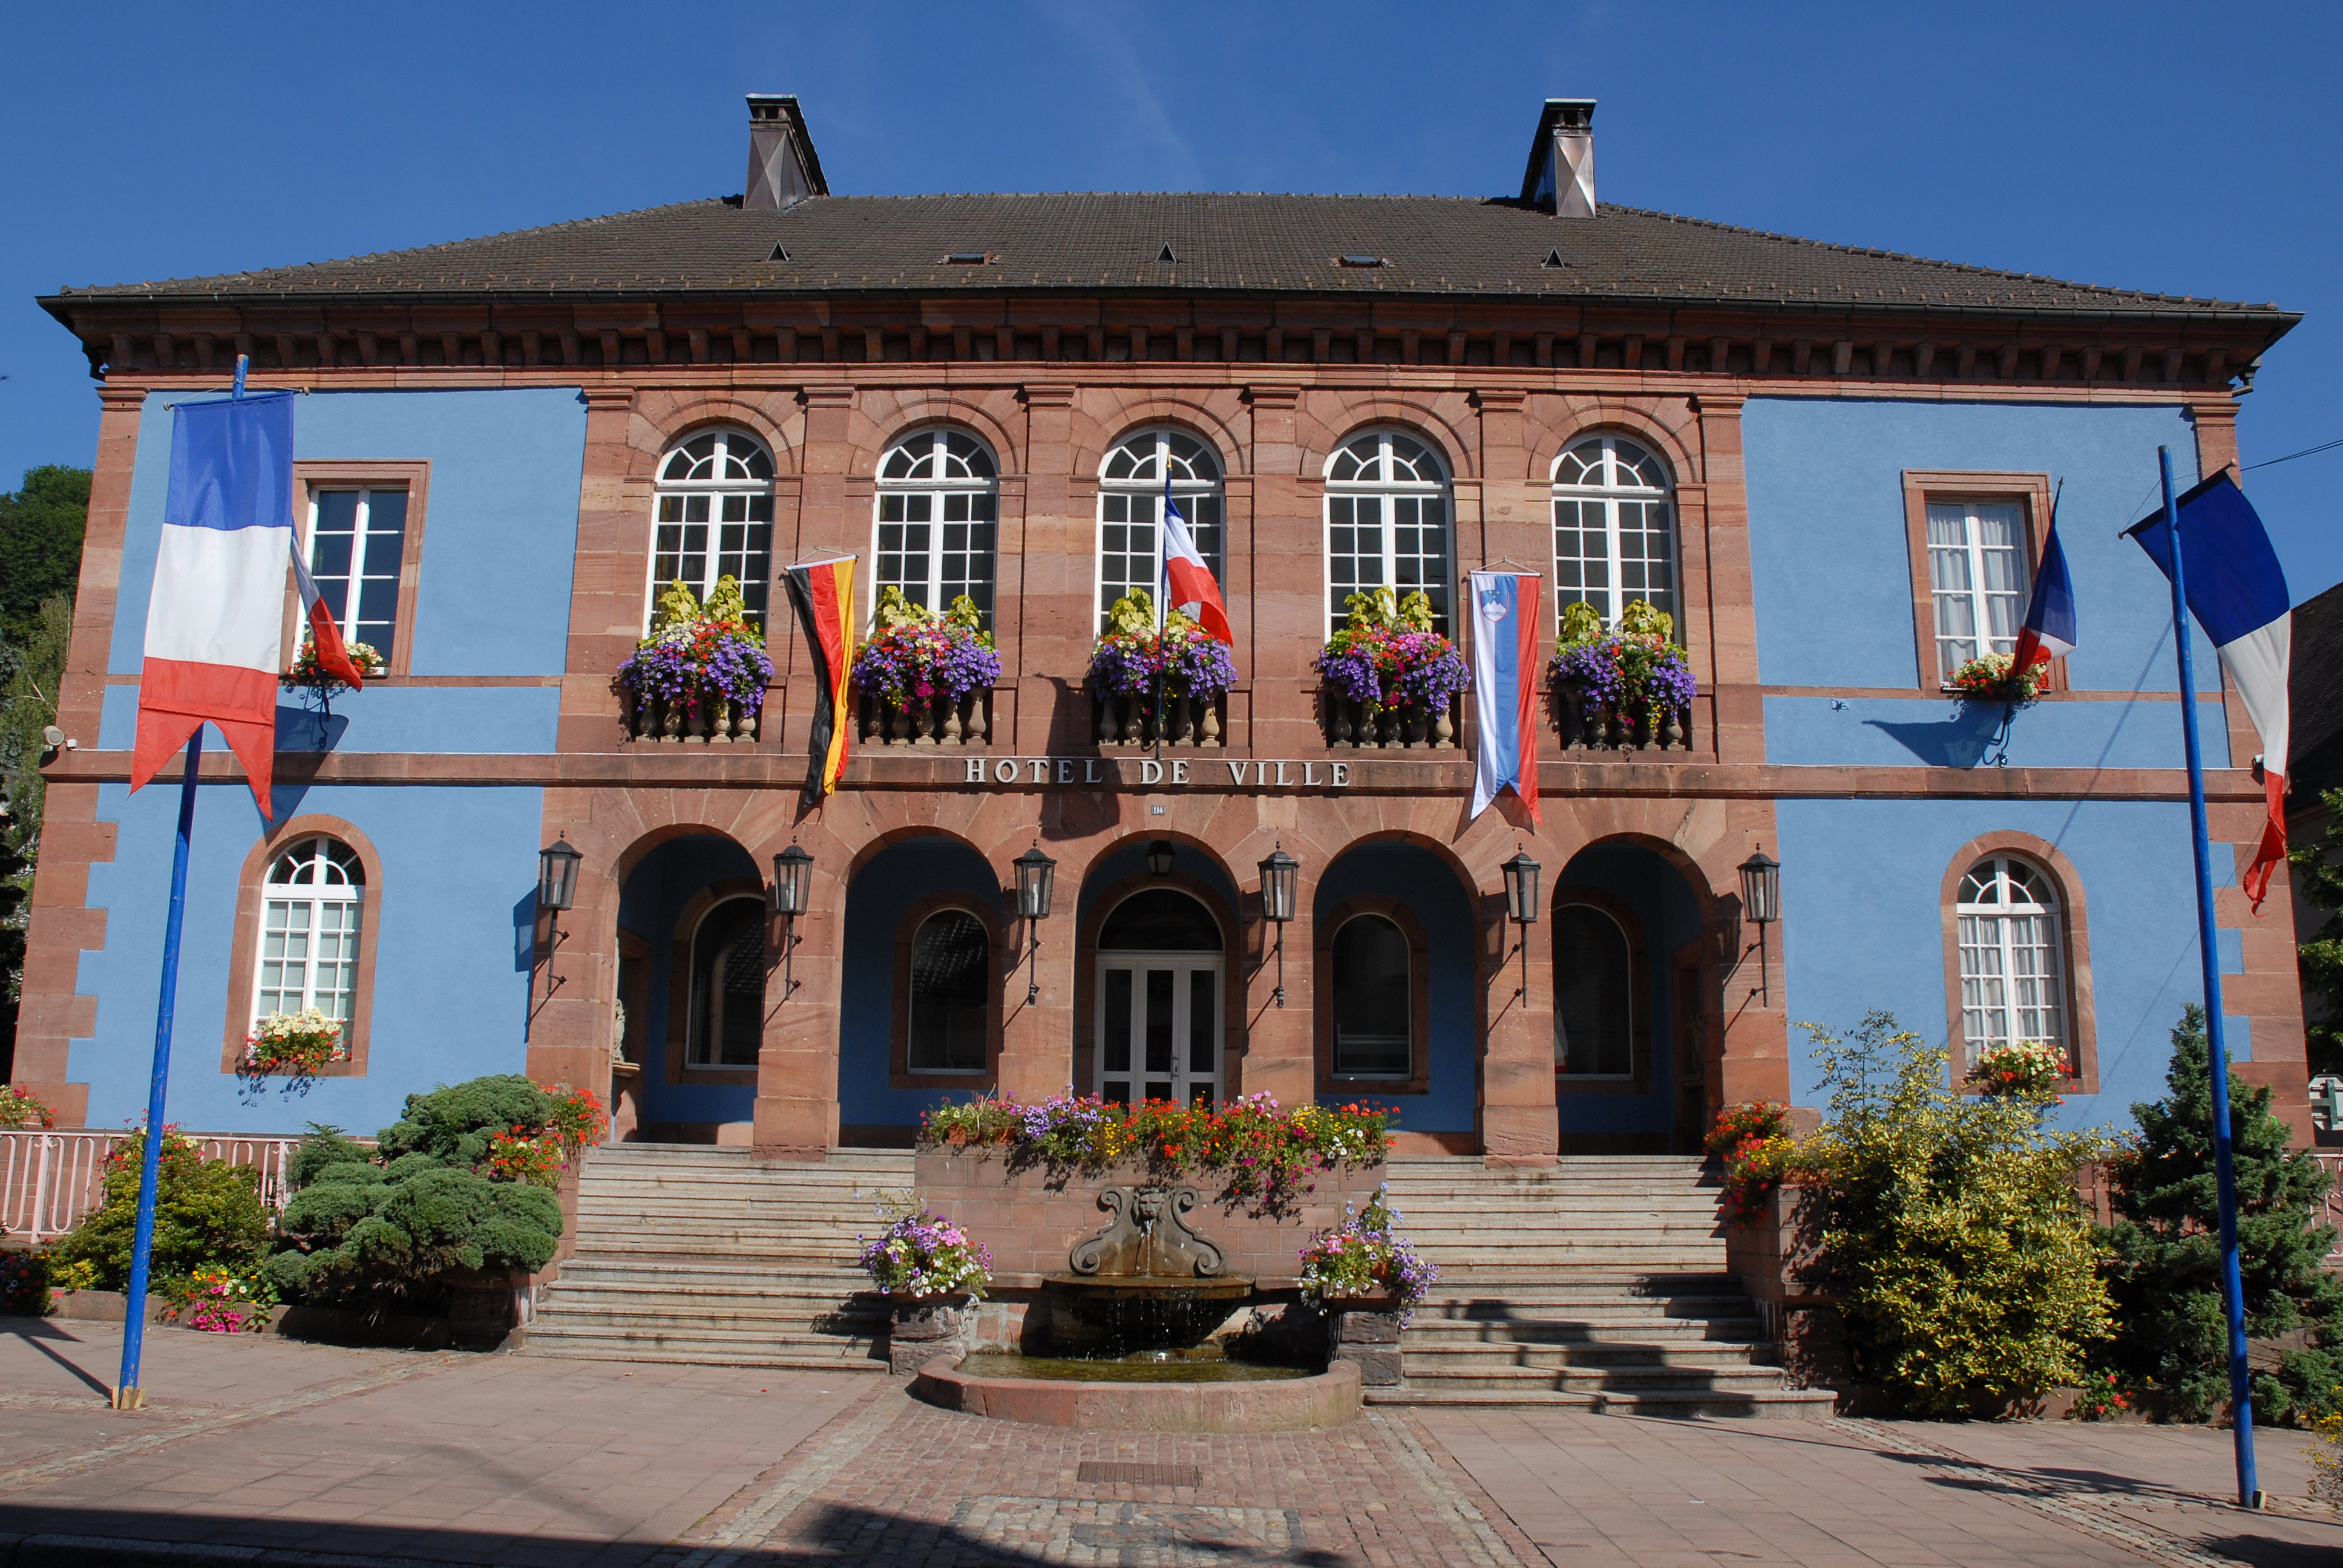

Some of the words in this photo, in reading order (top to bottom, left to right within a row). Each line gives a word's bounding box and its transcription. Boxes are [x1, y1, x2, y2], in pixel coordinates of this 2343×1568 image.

[965, 758, 1103, 783] HOTEL
[1139, 760, 1190, 785] DE
[1227, 761, 1351, 787] VILLE
